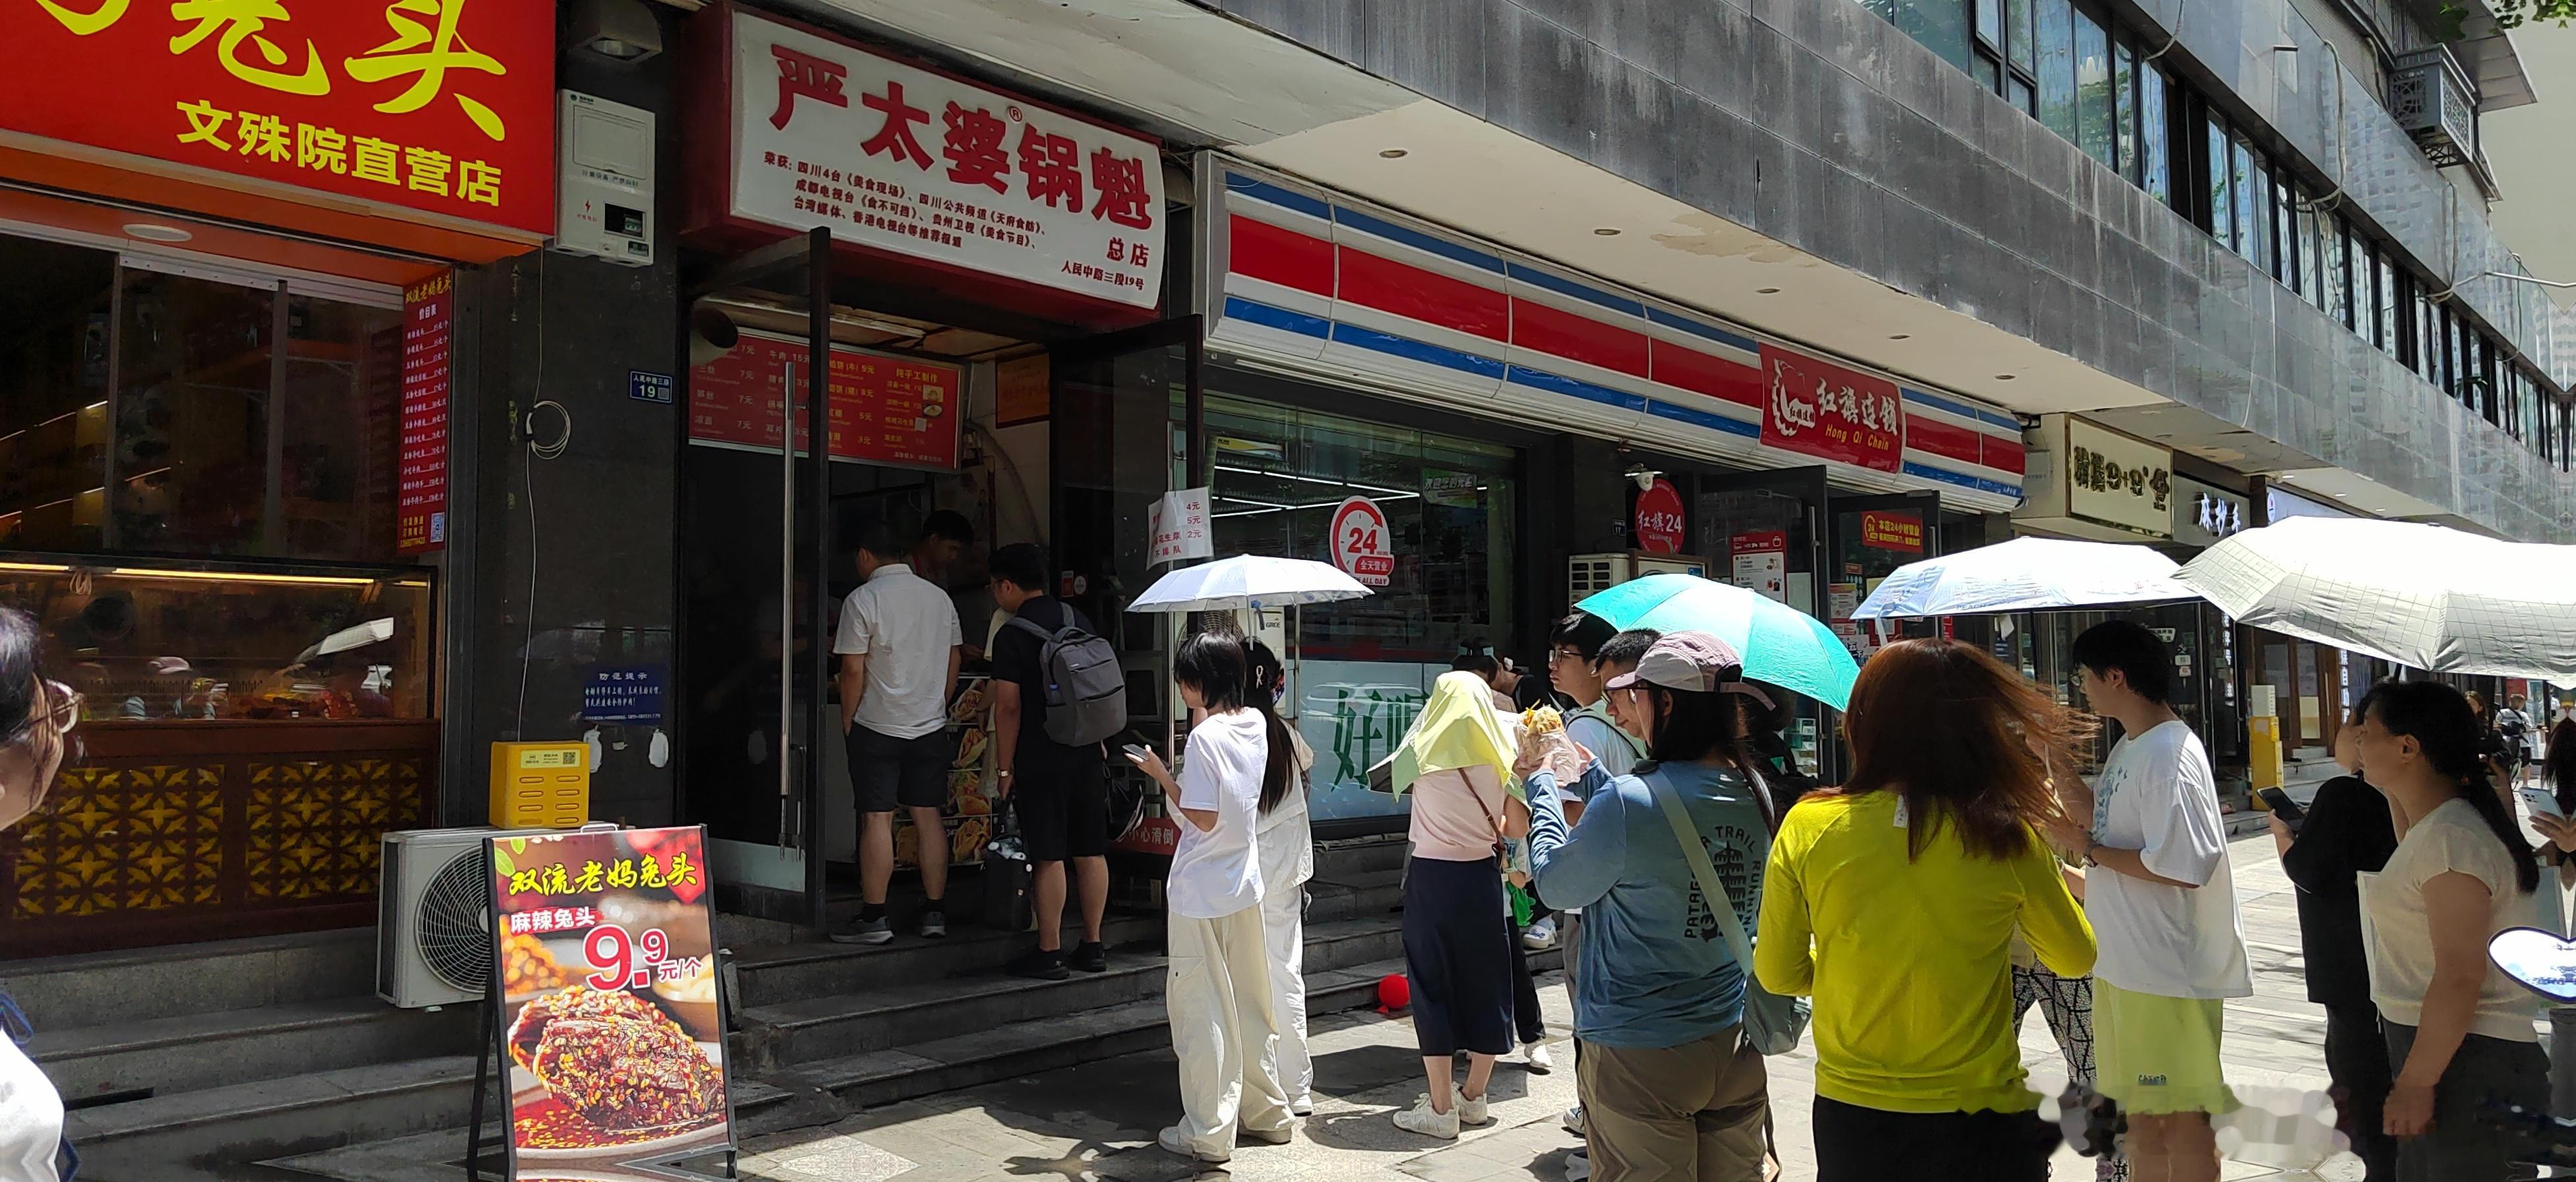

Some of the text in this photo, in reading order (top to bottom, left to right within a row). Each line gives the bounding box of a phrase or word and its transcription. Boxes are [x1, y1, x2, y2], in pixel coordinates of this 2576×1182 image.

[36, 0, 507, 141] 兔头
[769, 44, 1153, 230] 严太婆锅魁
[176, 100, 503, 208] 文殊院直营店
[1106, 236, 1149, 268] 总店
[1060, 260, 1144, 291] 人民中路三段19号
[418, 304, 437, 321] 价目表
[740, 370, 754, 380] 7元
[639, 385, 656, 398] 19
[738, 395, 754, 405] 7元
[1816, 376, 1898, 437] 红旗连锁
[737, 420, 752, 430] 7元
[1825, 423, 1890, 451] Hong Qi Chain
[1186, 501, 1200, 511] 4元
[1187, 515, 1201, 524] 5元
[1188, 530, 1202, 538] 2元
[1347, 527, 1378, 555] 24
[1360, 559, 1389, 571] 全天营业
[1362, 576, 1373, 584] ALL
[1129, 826, 1174, 846] 小心滑倒
[1715, 826, 1756, 854] TRAIL
[509, 852, 698, 897] 双流老妈兔头
[511, 906, 596, 934] 麻辣兔头
